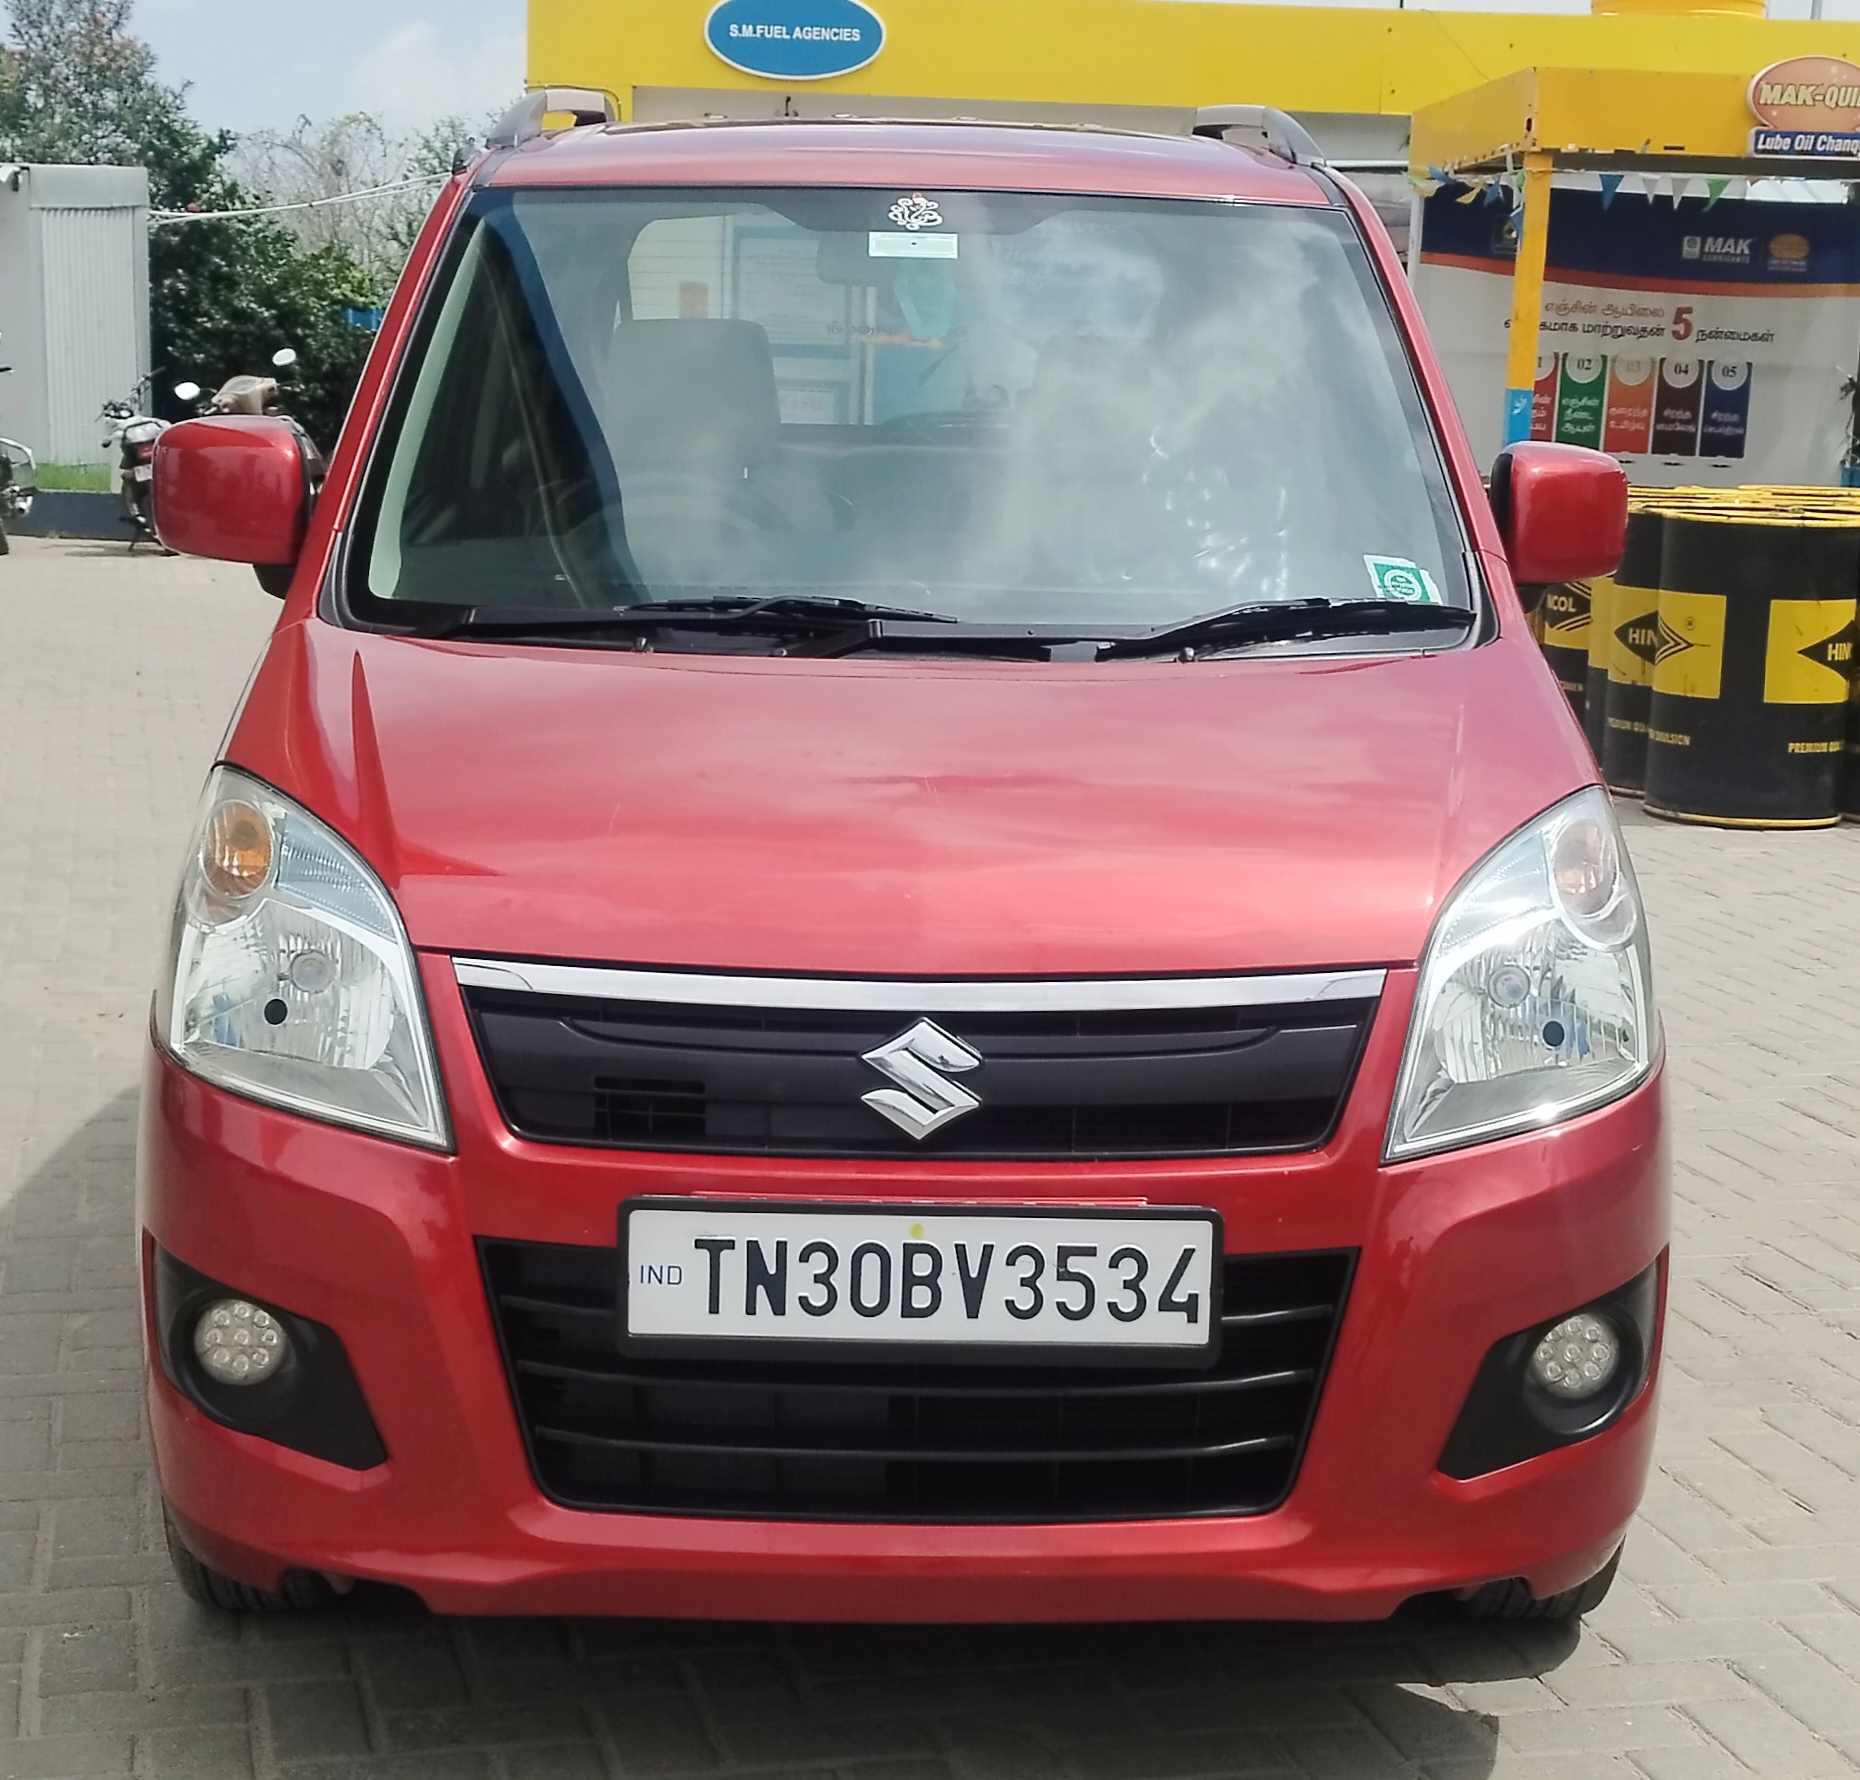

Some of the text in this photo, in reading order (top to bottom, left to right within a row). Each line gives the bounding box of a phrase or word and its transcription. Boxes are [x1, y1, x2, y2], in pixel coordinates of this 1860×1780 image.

[729, 24, 861, 41] S.M.FUEL AGENCIES
[1758, 83, 1860, 109] MAK-QUI
[1757, 134, 1860, 157] Lube Oil Chang
[1704, 237, 1752, 254] MAK
[1545, 299, 1664, 319] எஞ்சின் ஆயிலை
[1672, 306, 1694, 341] 5
[1695, 327, 1775, 343] நன்மைகள்
[1577, 358, 1593, 371] 02
[1674, 363, 1690, 375] 04
[1722, 366, 1738, 378] 05
[639, 1238, 1199, 1323] IND TN30BV3534
